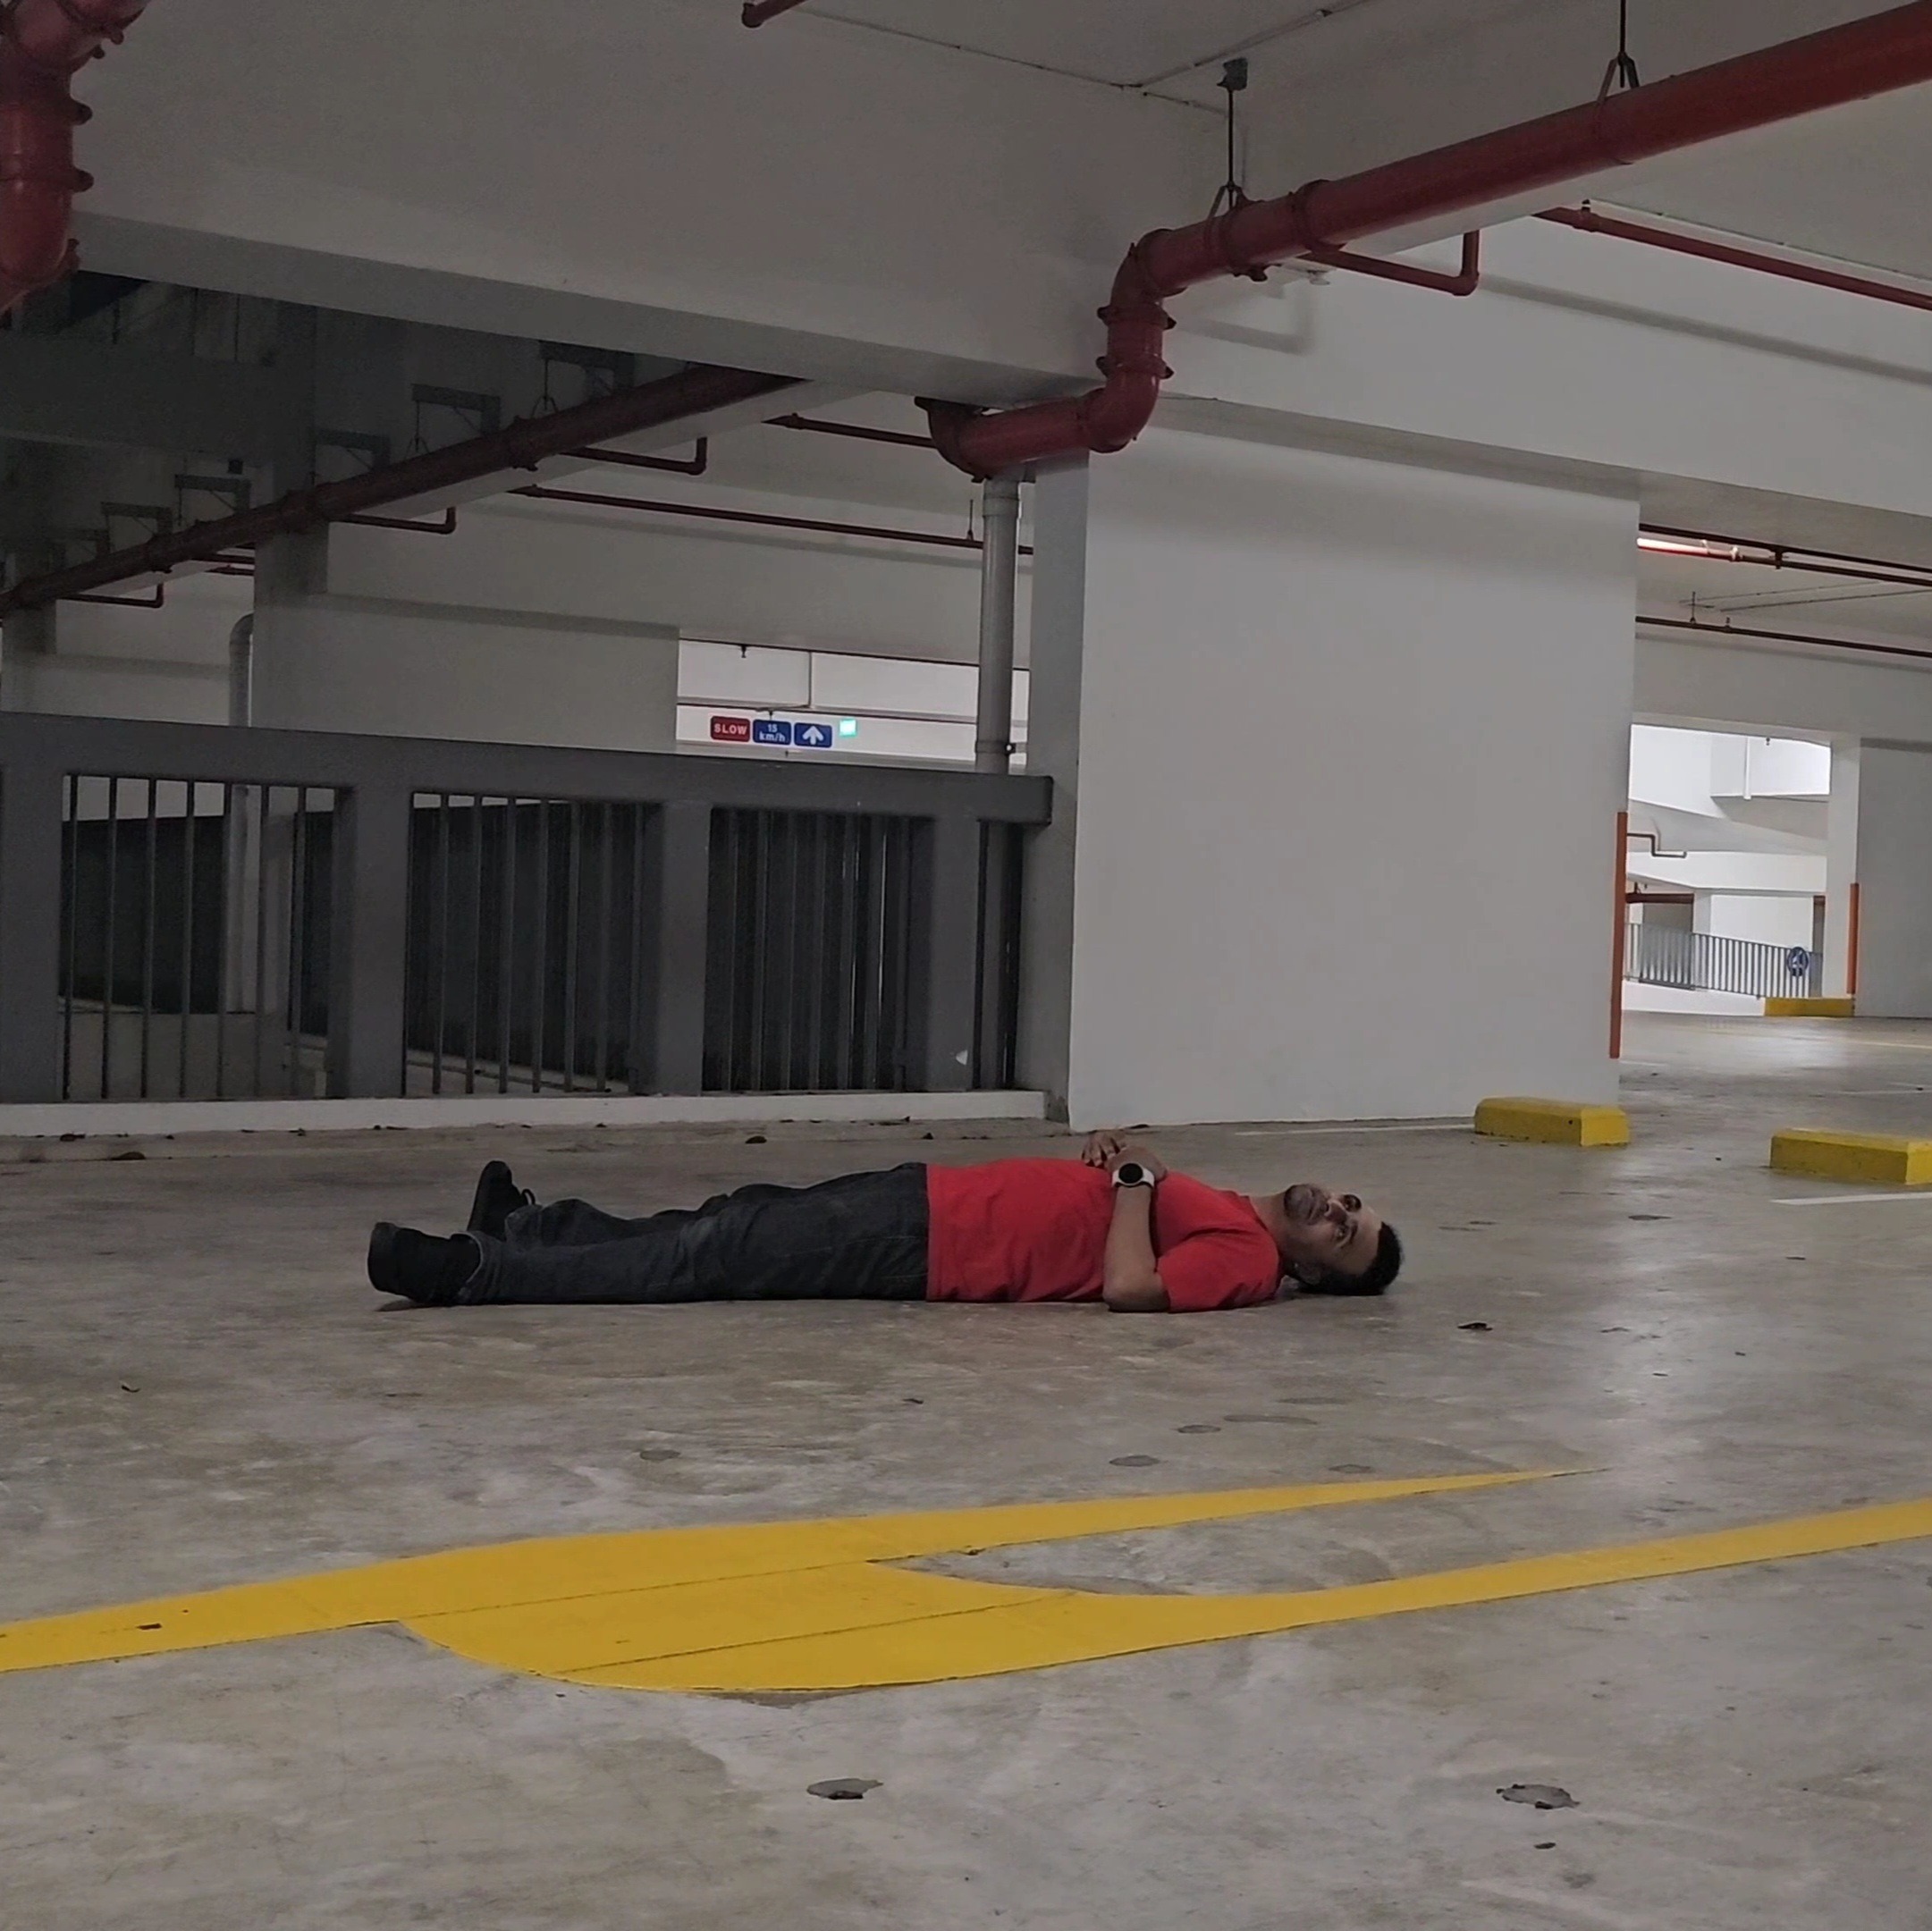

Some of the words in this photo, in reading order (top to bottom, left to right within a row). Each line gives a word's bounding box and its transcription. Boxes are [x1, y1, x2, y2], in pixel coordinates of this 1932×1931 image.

[713, 723, 748, 735] SLOW
[767, 723, 778, 732] 15
[759, 731, 786, 742] km/h
